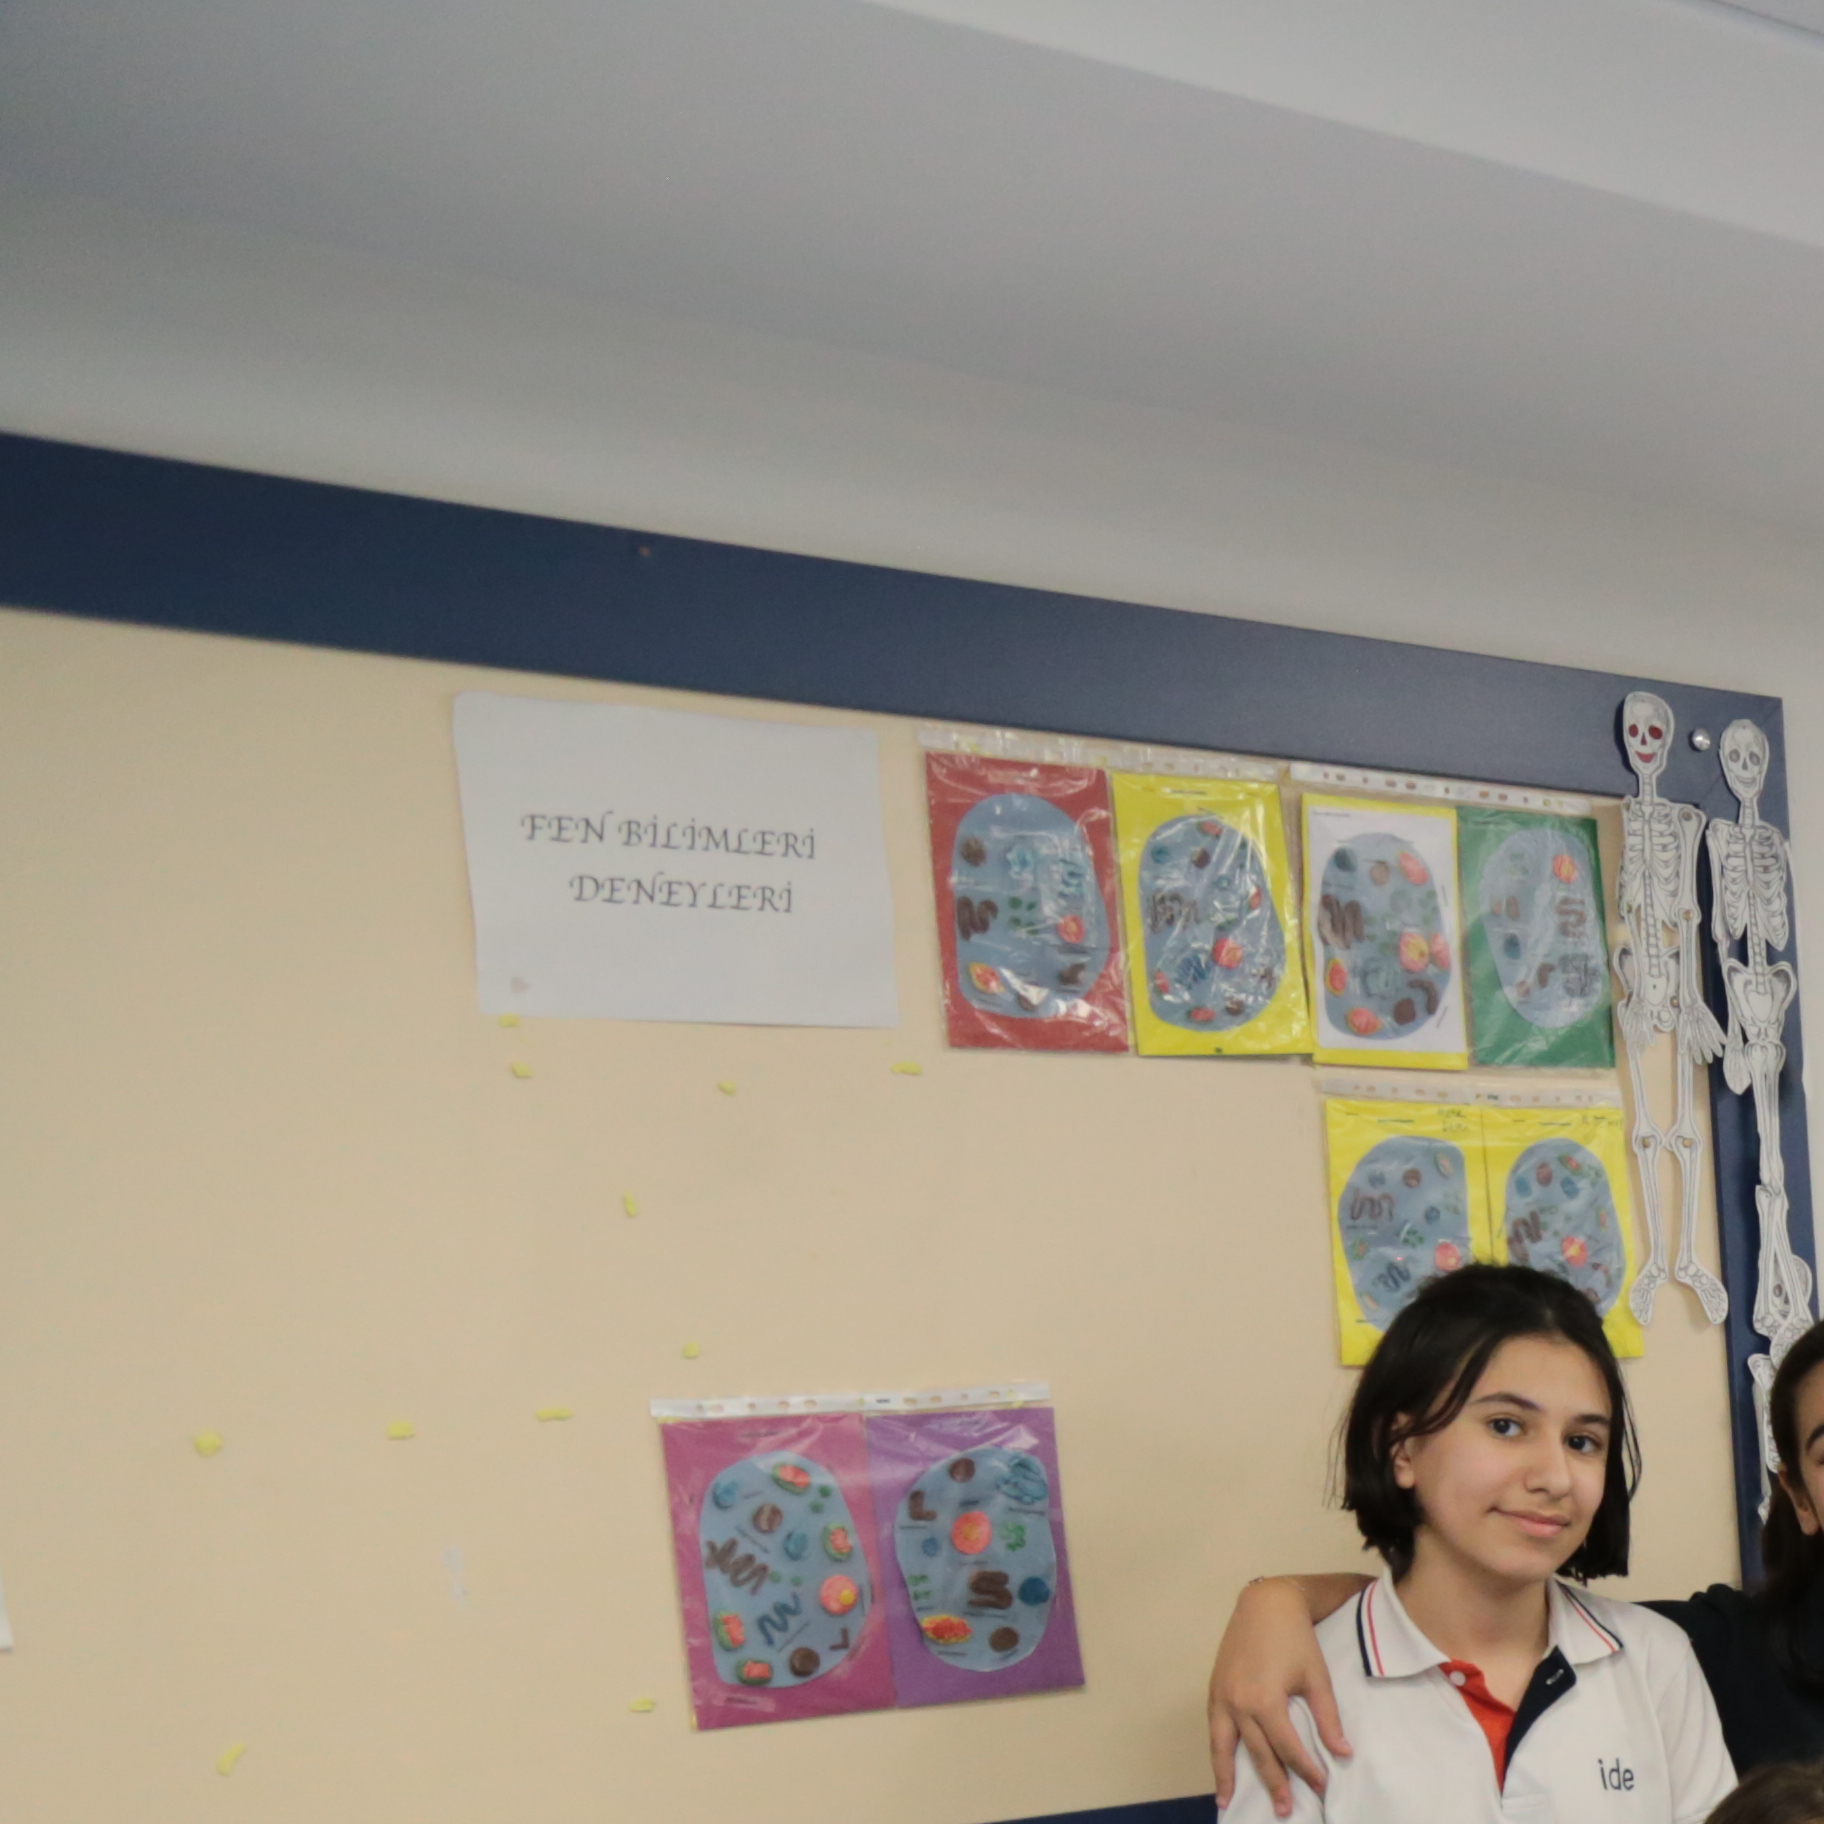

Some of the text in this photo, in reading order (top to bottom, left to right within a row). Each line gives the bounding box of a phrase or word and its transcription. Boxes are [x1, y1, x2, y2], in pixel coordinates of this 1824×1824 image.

[521, 811, 817, 860] FEN BİLİMLERİ
[569, 872, 794, 913] DENEYLERİ
[1598, 1758, 1634, 1790] ide
